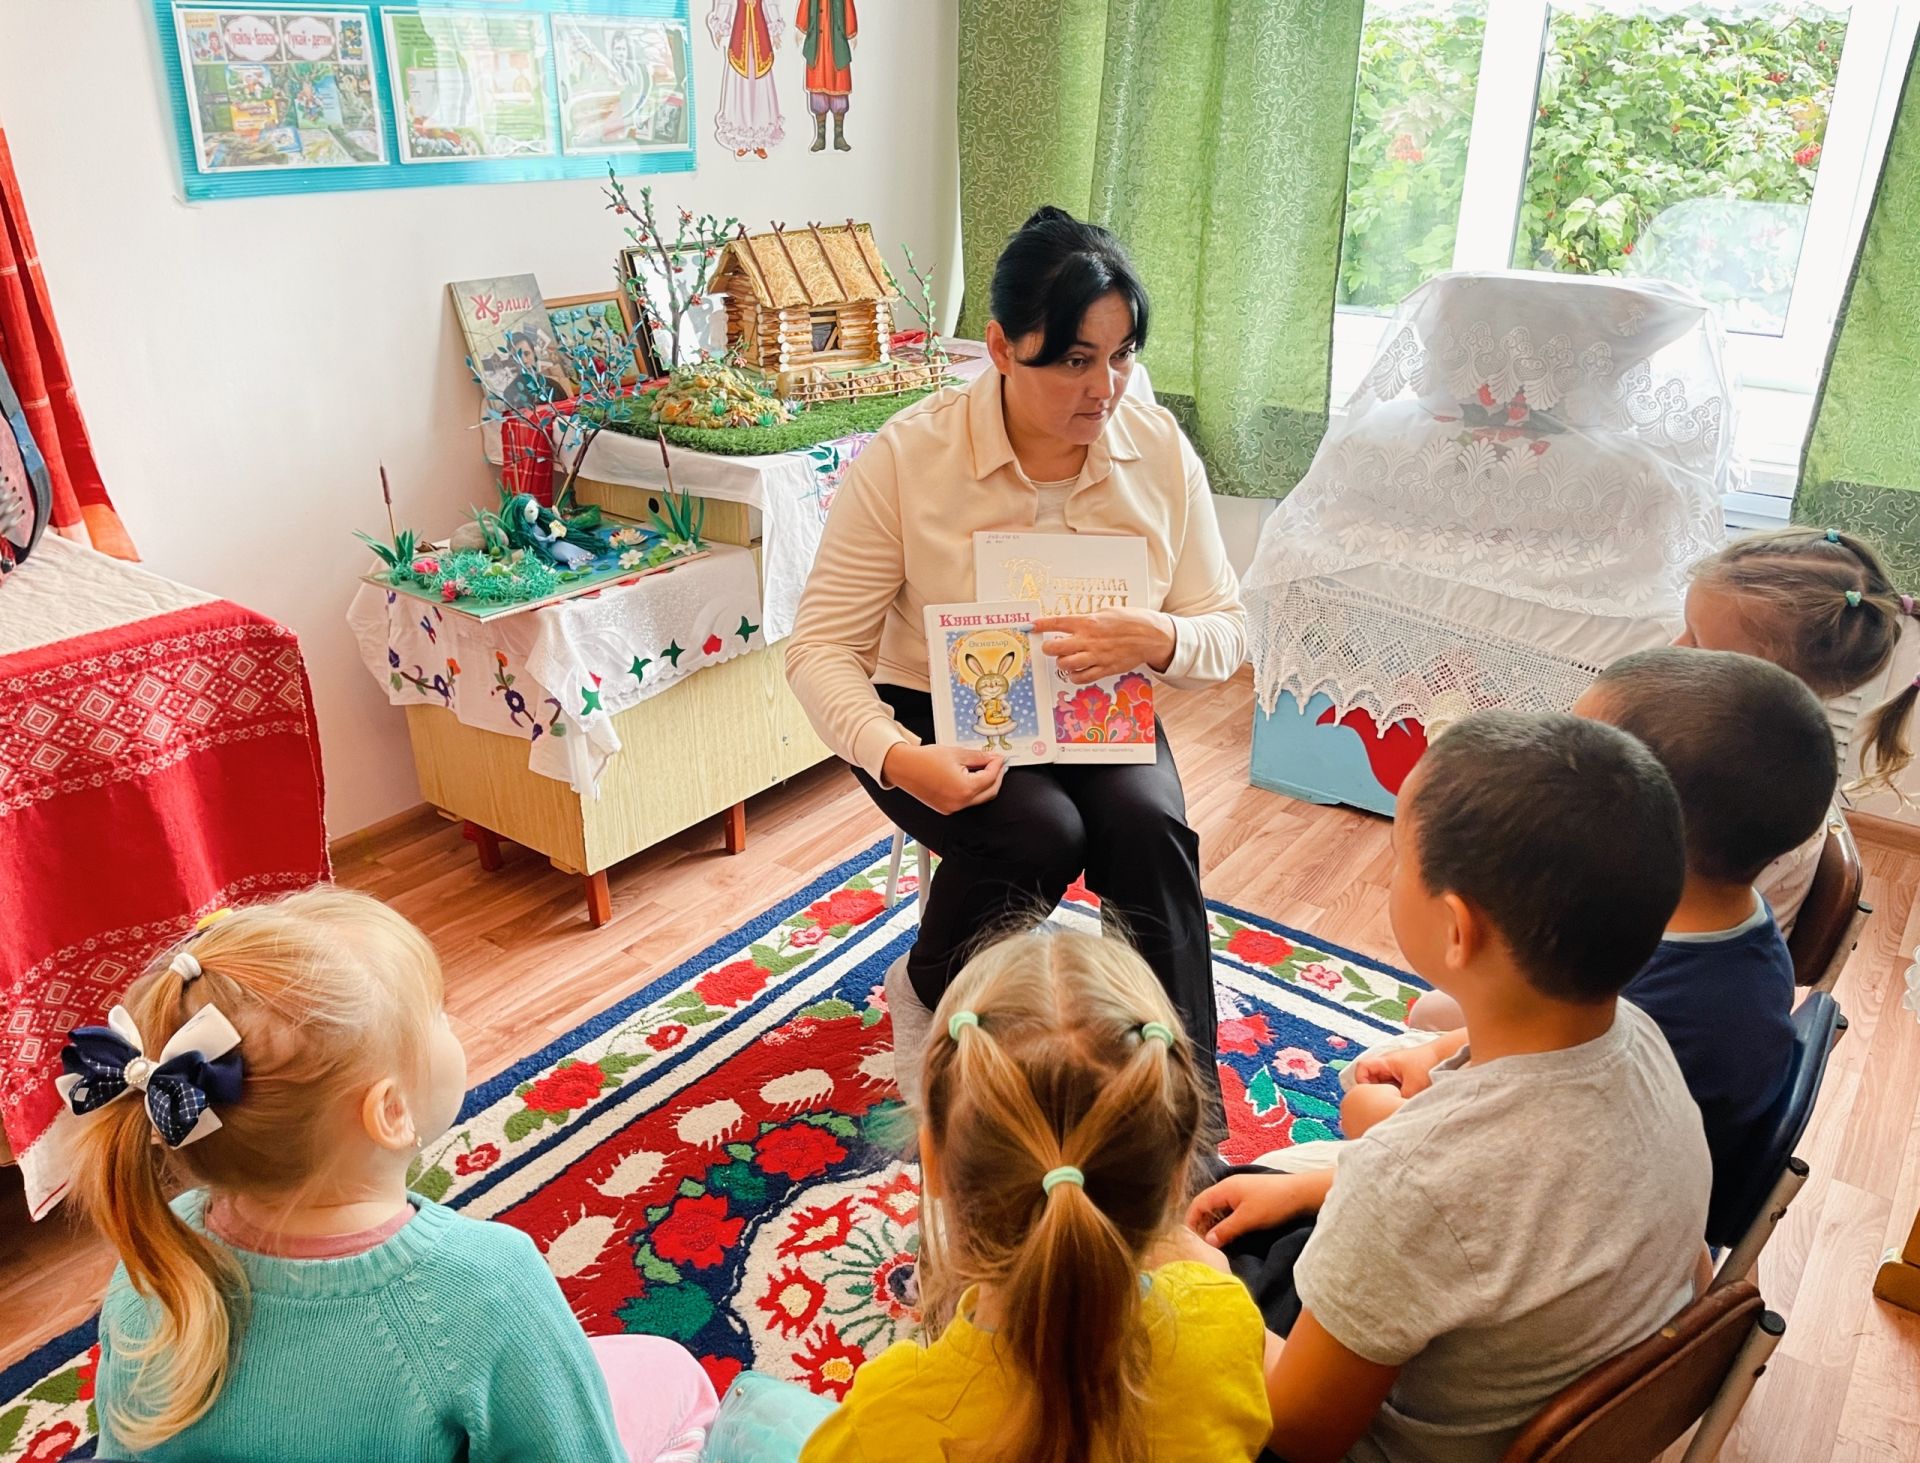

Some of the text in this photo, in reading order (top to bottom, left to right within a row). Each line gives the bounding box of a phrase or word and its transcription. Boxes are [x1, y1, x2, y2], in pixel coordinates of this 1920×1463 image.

[470, 294, 532, 325] Җәлил
[939, 611, 1032, 628] Куян кызы
